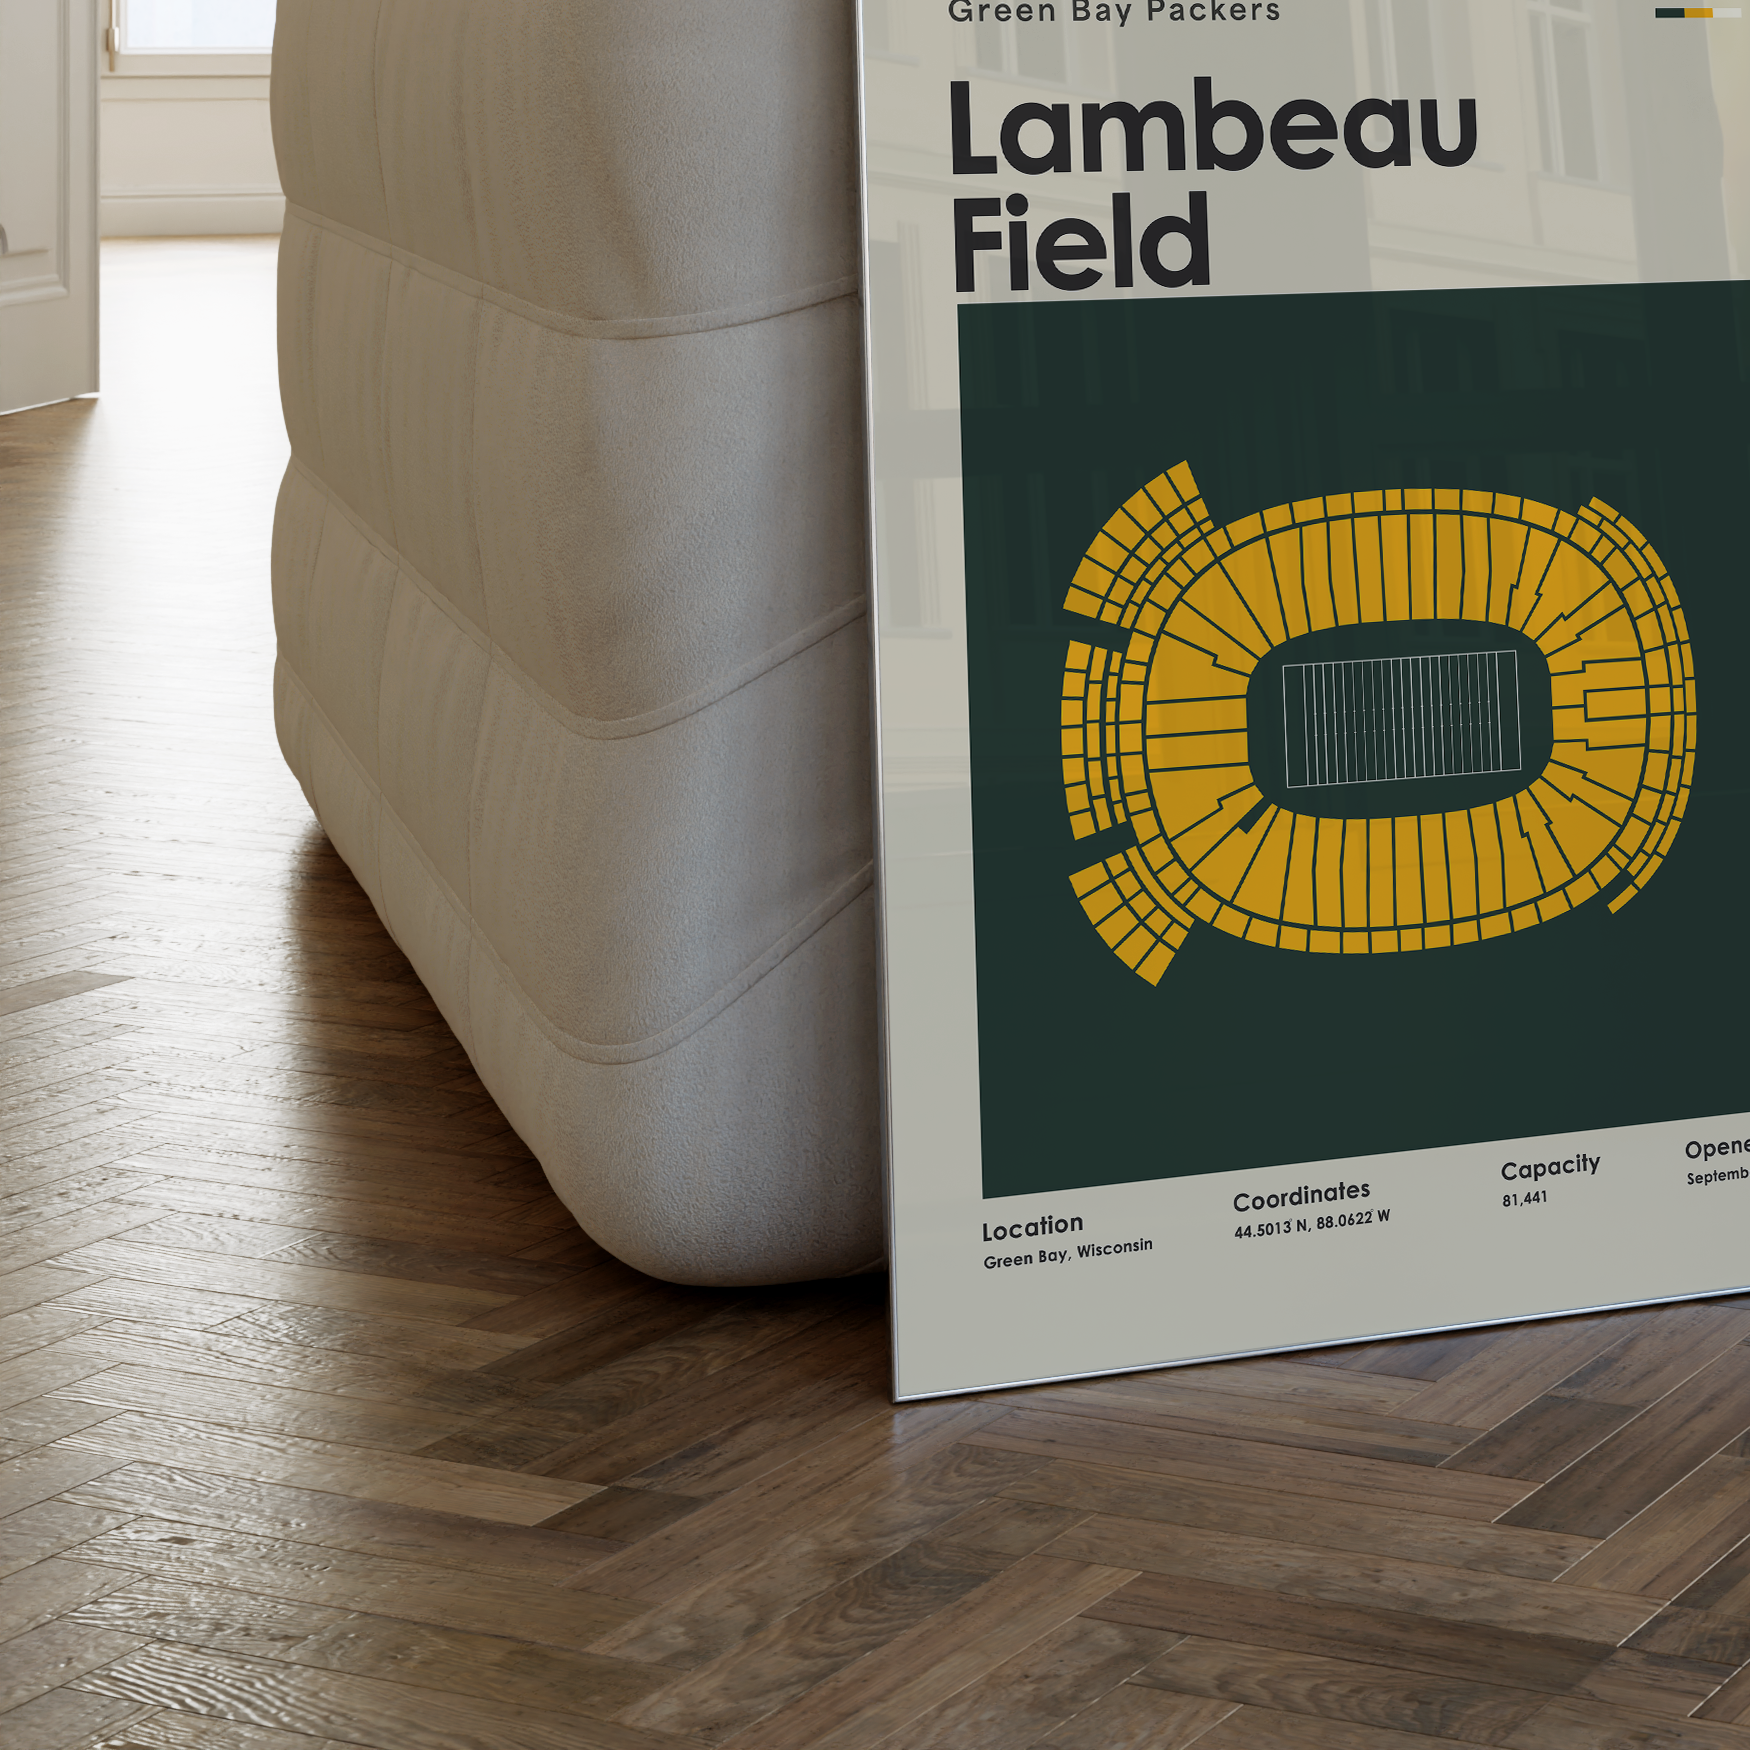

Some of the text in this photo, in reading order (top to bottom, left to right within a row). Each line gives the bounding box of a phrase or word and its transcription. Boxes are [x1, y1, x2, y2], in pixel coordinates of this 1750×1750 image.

[950, 76, 1478, 176] Lambeau
[953, 190, 1211, 293] Field
[1501, 1153, 1601, 1182] Capacity
[1233, 1181, 1371, 1212] Coordinates
[1502, 1190, 1547, 1208] 81,441
[982, 1214, 1083, 1242] Location
[1296, 1218, 1312, 1233] N,
[1377, 1208, 1391, 1222] W
[983, 1237, 1153, 1270] Green Bay, Wisconsin
